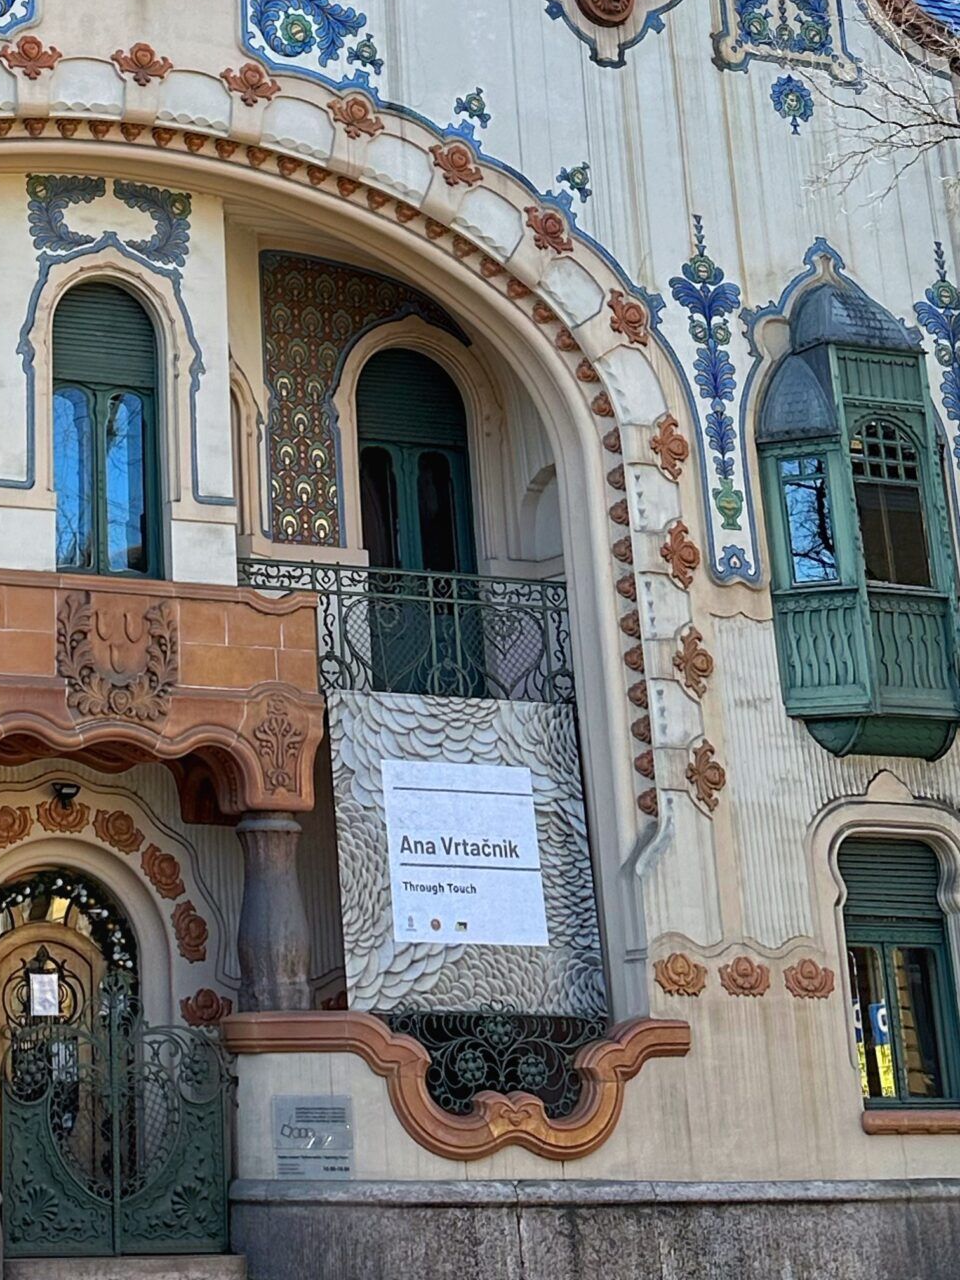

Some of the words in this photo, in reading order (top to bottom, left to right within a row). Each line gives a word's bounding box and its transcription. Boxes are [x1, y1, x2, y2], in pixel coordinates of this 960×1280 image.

[400, 835, 436, 856] Ana
[441, 836, 520, 859] Vrtačnik
[402, 881, 445, 895] Through
[447, 883, 477, 894] Touch
